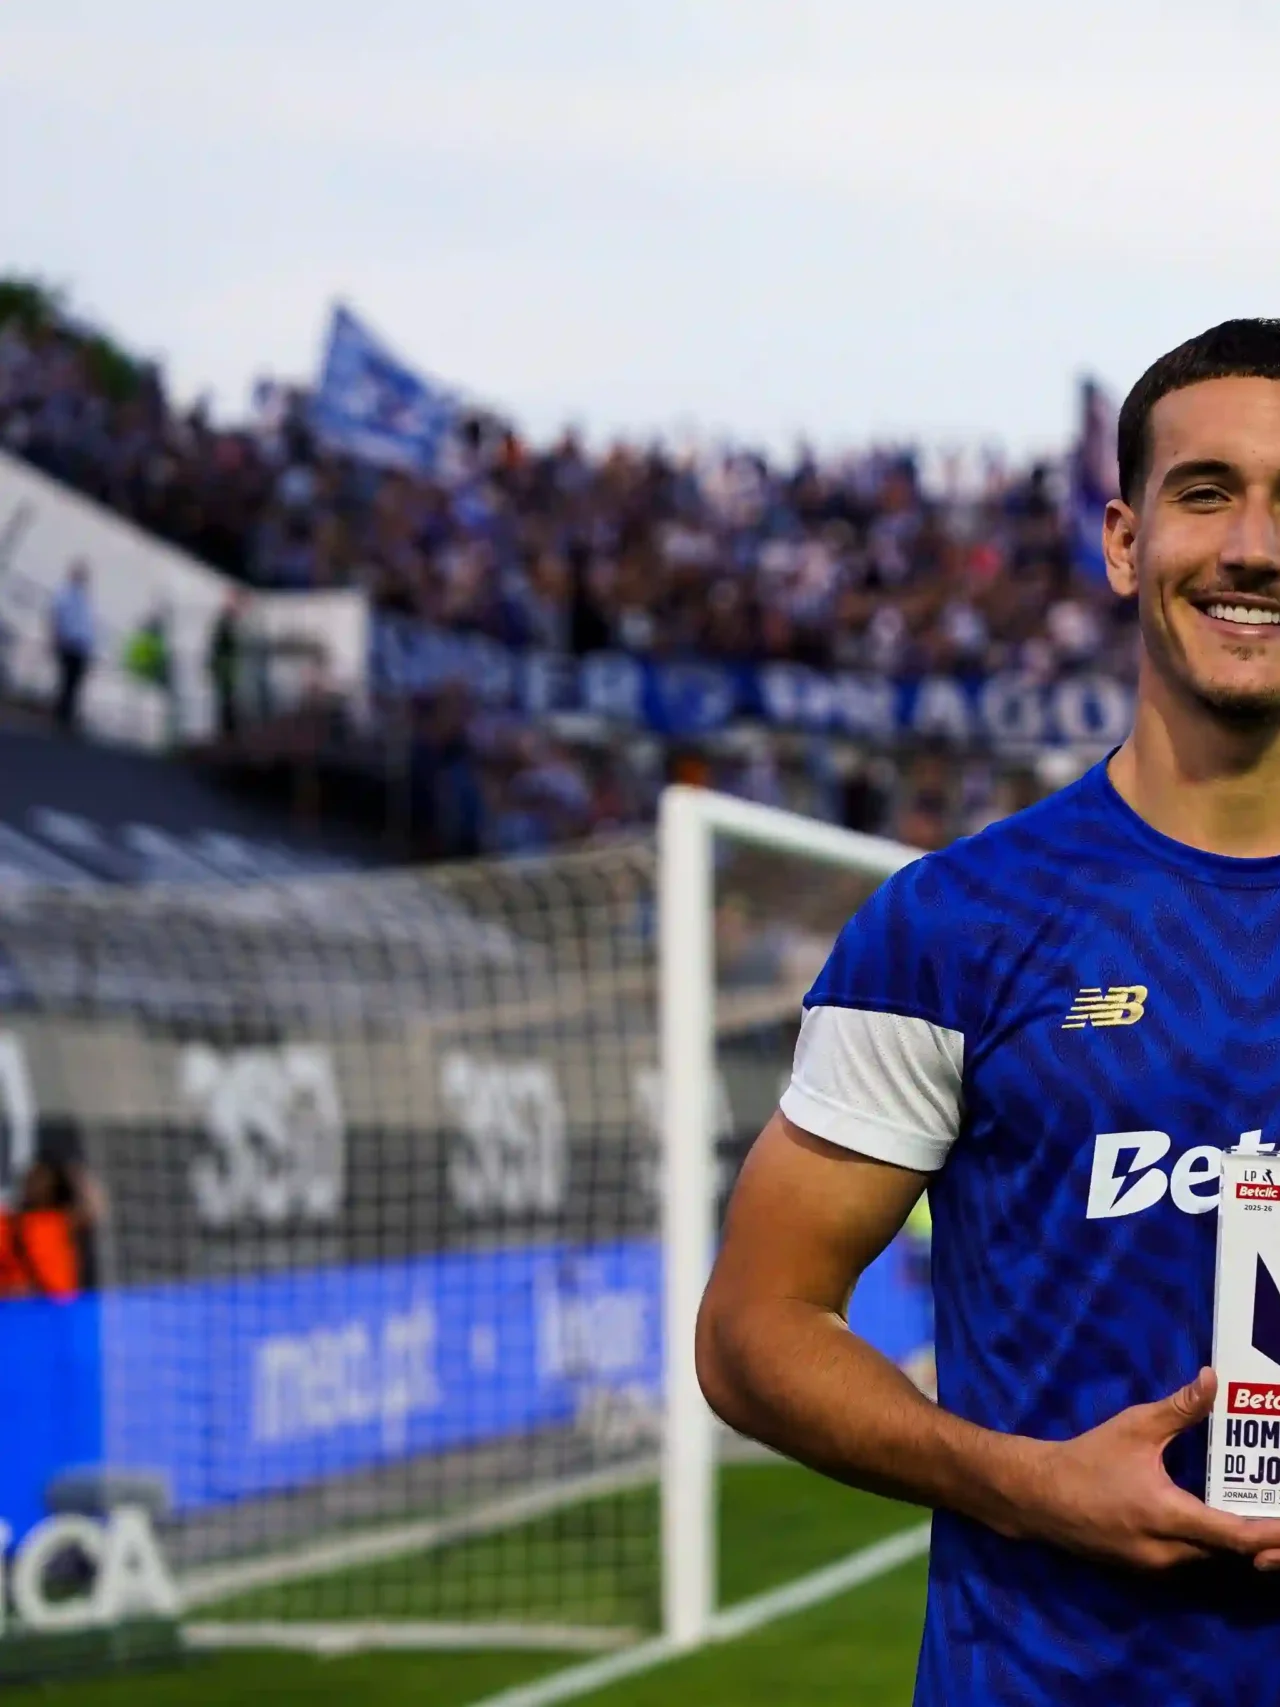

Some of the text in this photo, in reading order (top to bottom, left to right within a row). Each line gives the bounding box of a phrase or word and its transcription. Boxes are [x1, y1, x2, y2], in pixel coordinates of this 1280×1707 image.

[1244, 1169, 1257, 1182] LP
[1238, 1186, 1279, 1199] Betclic
[1244, 1204, 1273, 1212] 2025-26
[1224, 1454, 1246, 1475] DO
[1223, 1490, 1258, 1499] JORNADA
[1264, 1492, 1272, 1501] 31
